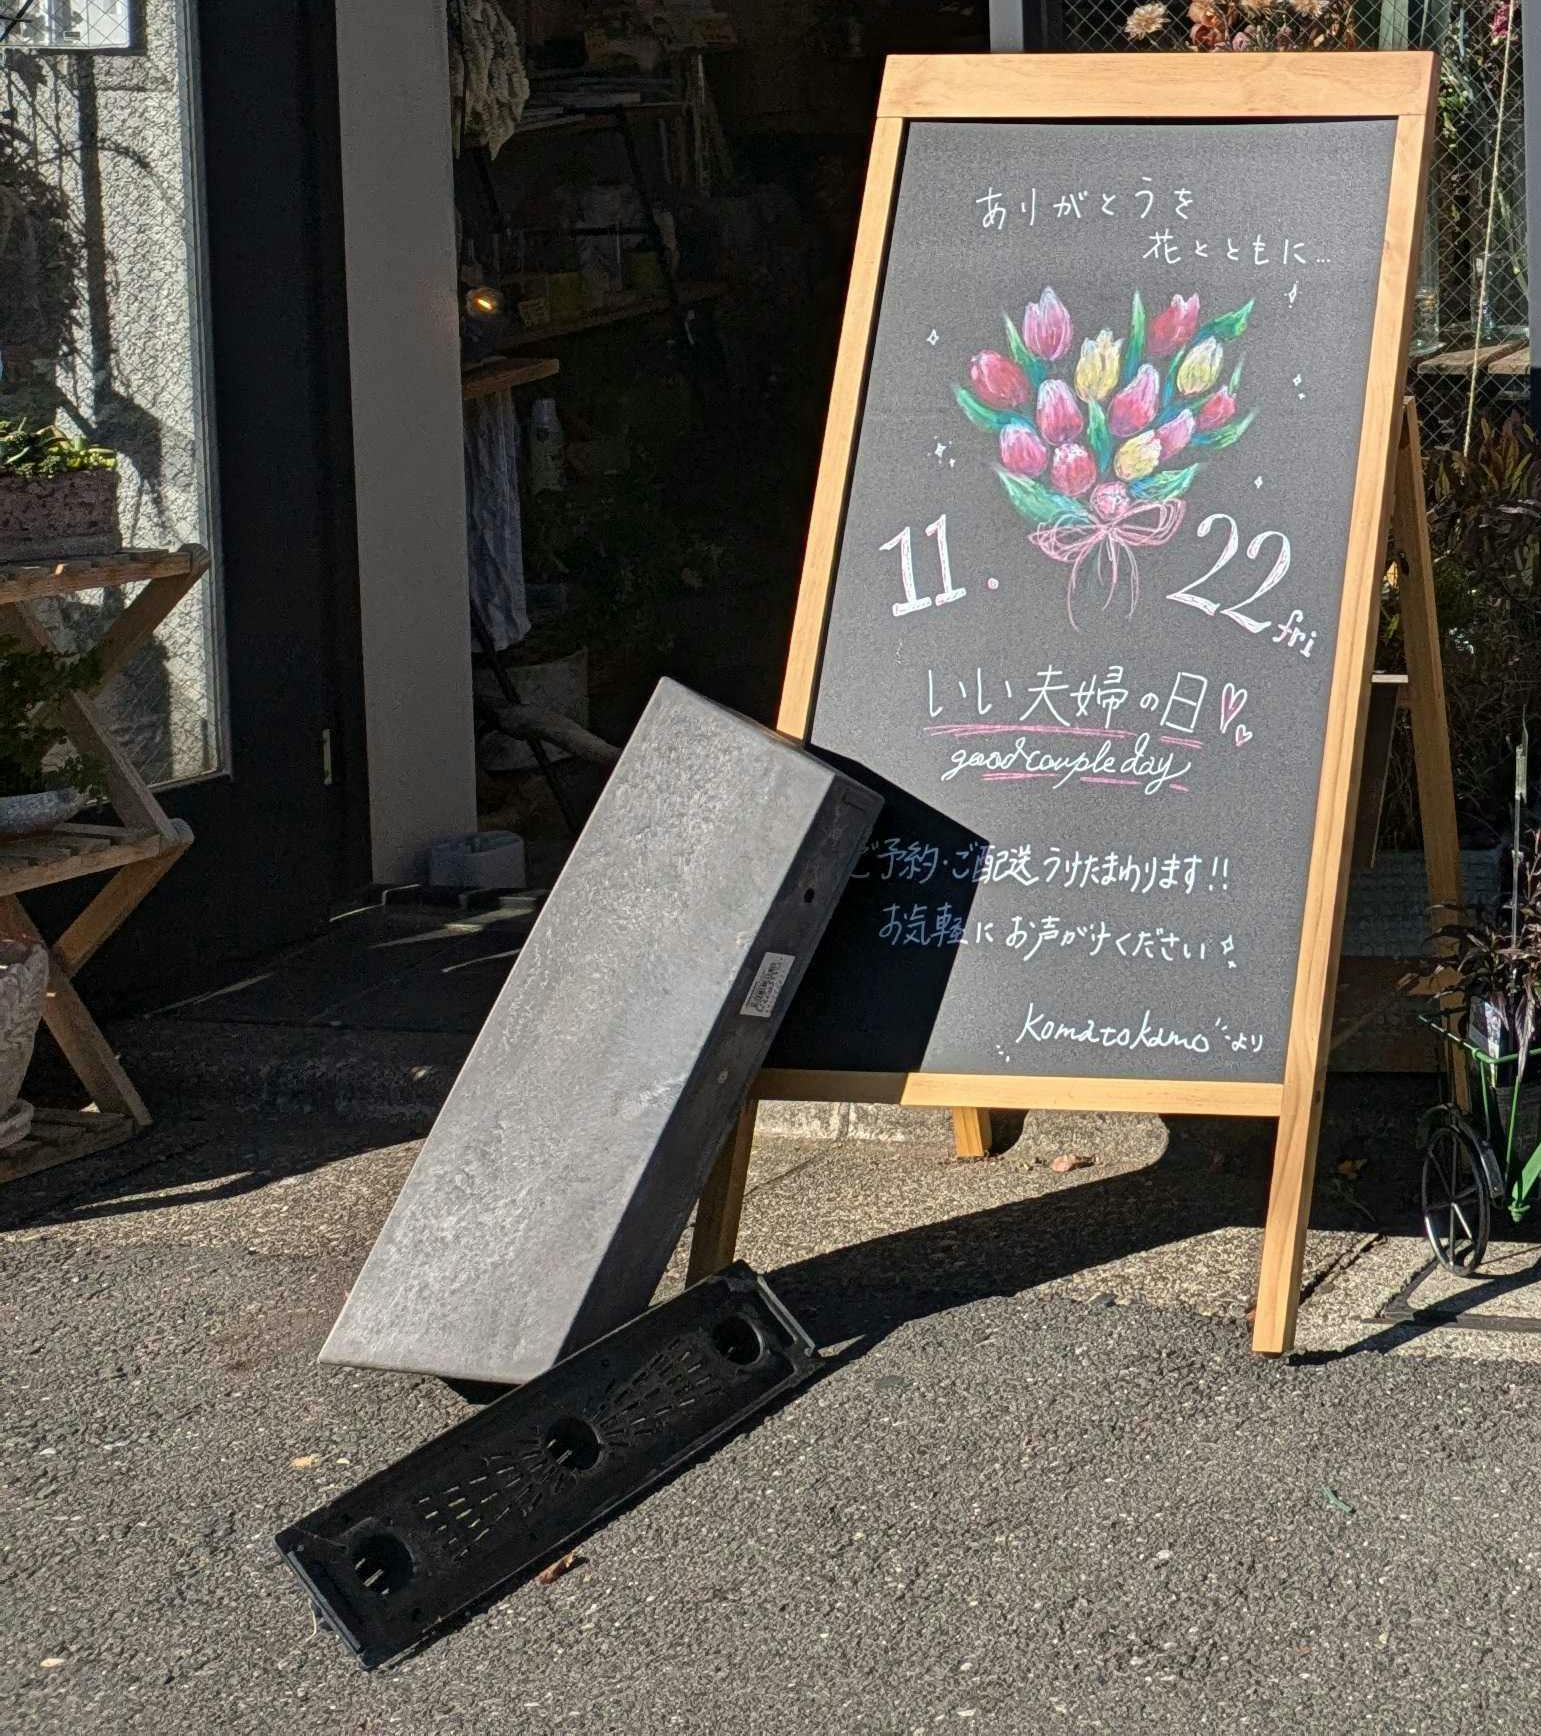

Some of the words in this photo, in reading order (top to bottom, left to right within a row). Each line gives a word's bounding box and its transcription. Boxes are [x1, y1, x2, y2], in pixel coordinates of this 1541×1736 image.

[975, 177, 1195, 228] ありがとうを
[1167, 513, 1291, 633] 22
[1273, 612, 1317, 657] fri
[928, 665, 1207, 732] いい夫婦の日
[1121, 734, 1190, 794] day
